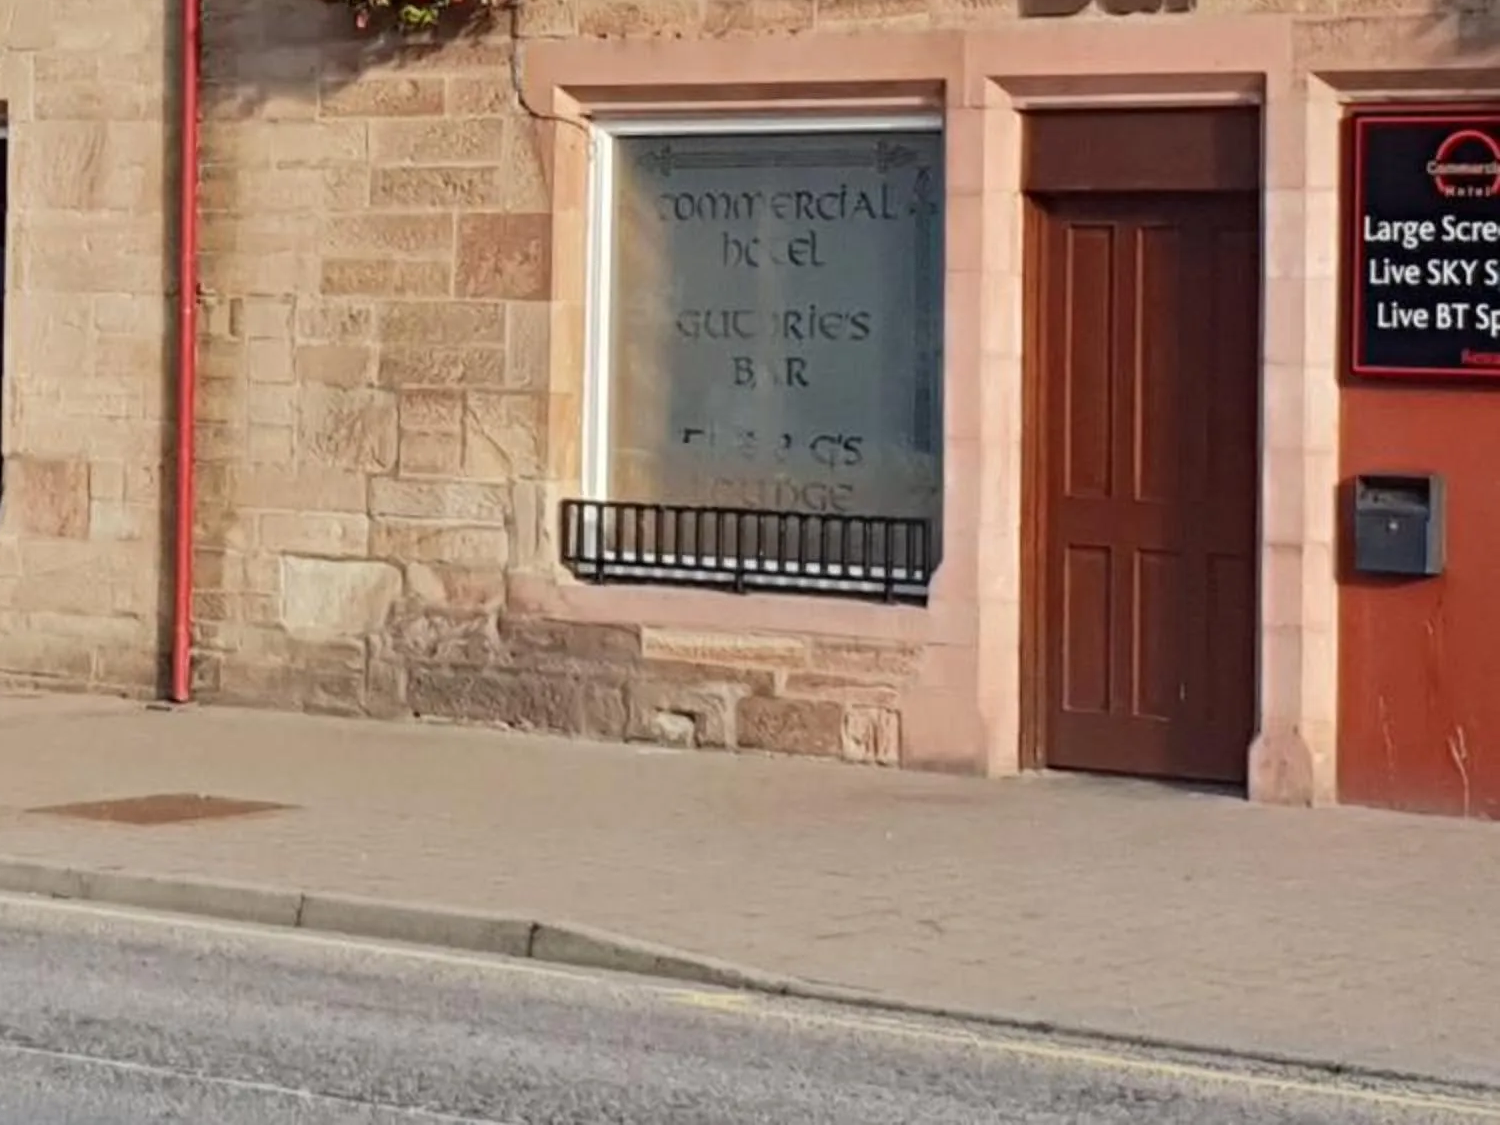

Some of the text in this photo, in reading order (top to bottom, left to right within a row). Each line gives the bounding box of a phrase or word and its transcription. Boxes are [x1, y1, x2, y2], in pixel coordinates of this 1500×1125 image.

[1364, 214, 1500, 250] Large Scre
[1369, 257, 1421, 286] Live
[1426, 258, 1479, 286] SKY
[1376, 301, 1429, 330] Live
[1436, 302, 1470, 329] BT
